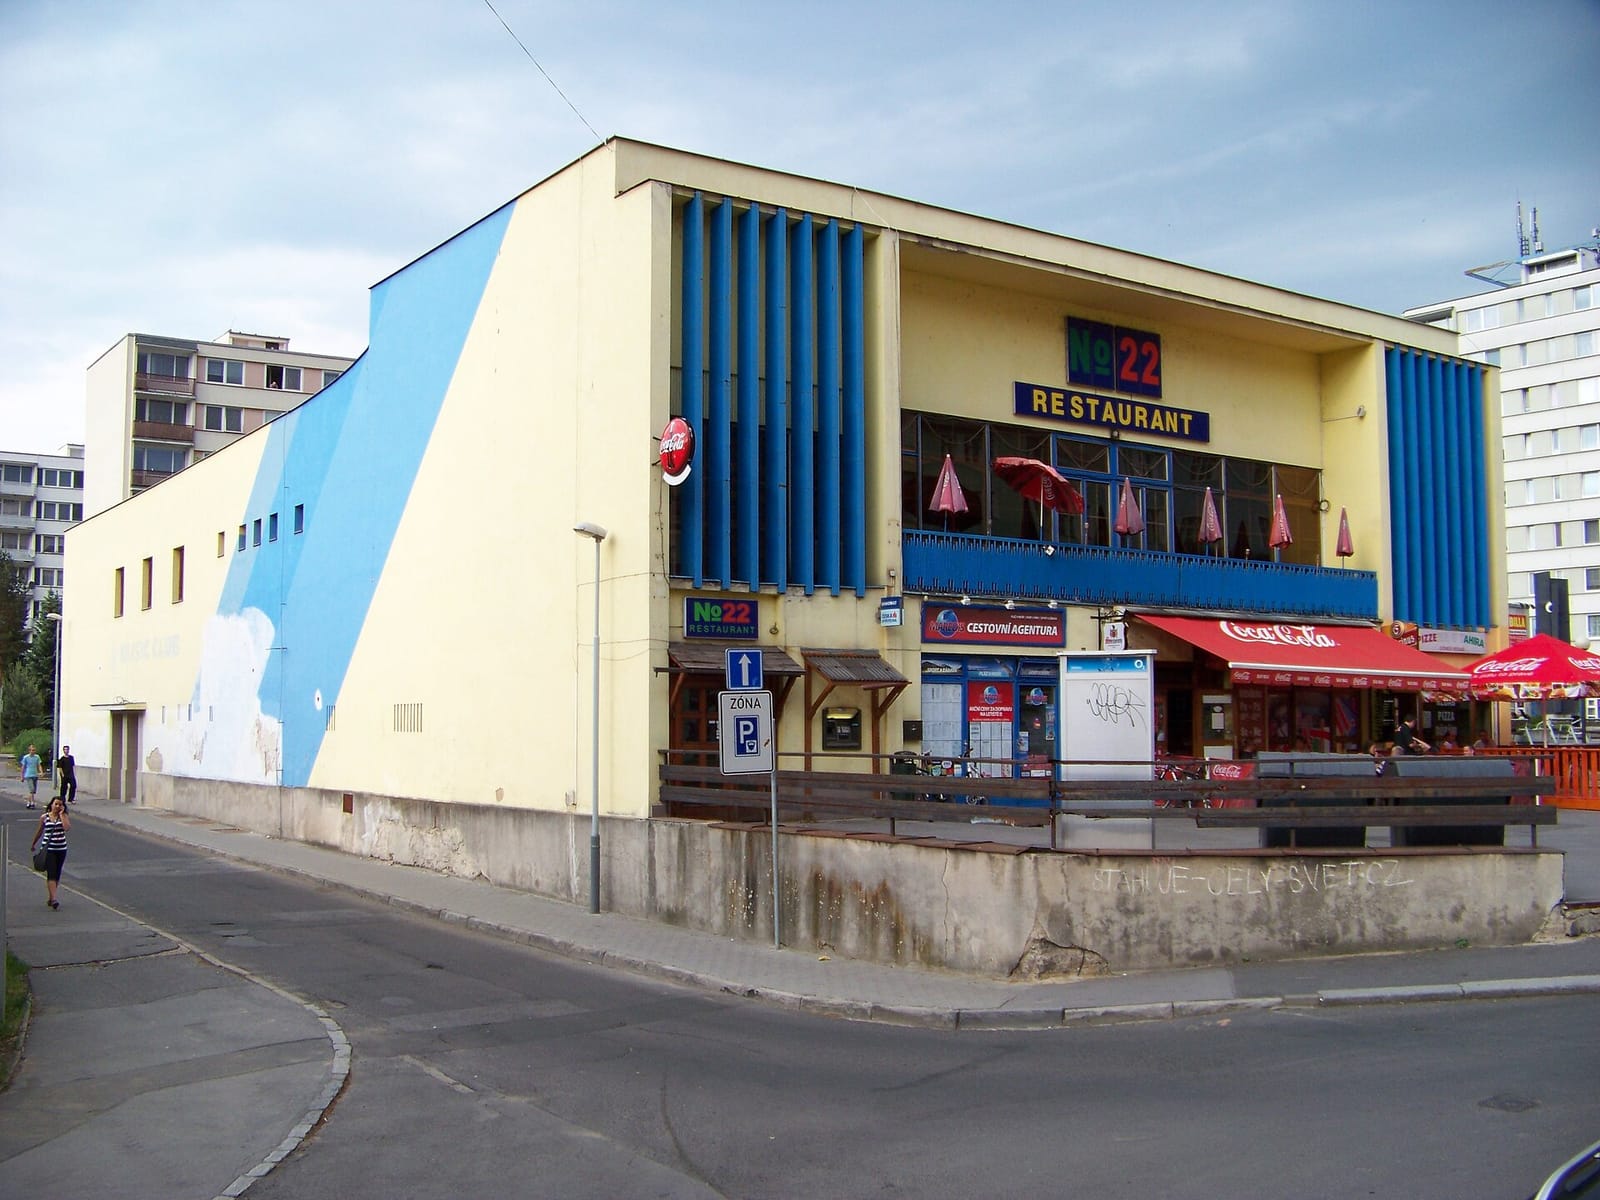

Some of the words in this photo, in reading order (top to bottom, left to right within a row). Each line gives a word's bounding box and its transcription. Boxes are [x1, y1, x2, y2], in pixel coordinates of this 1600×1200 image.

[1120, 336, 1160, 386] 22
[1033, 389, 1193, 435] RESTAURANT
[689, 624, 755, 634] RESTAURANT
[967, 622, 1011, 634] CESTOVNÍ
[1012, 624, 1058, 636] AGENTURA
[1220, 620, 1336, 647] Coca-Cola
[1463, 635, 1485, 647] AHIRA
[730, 695, 761, 709] ZÓNA
[740, 720, 754, 744] P
